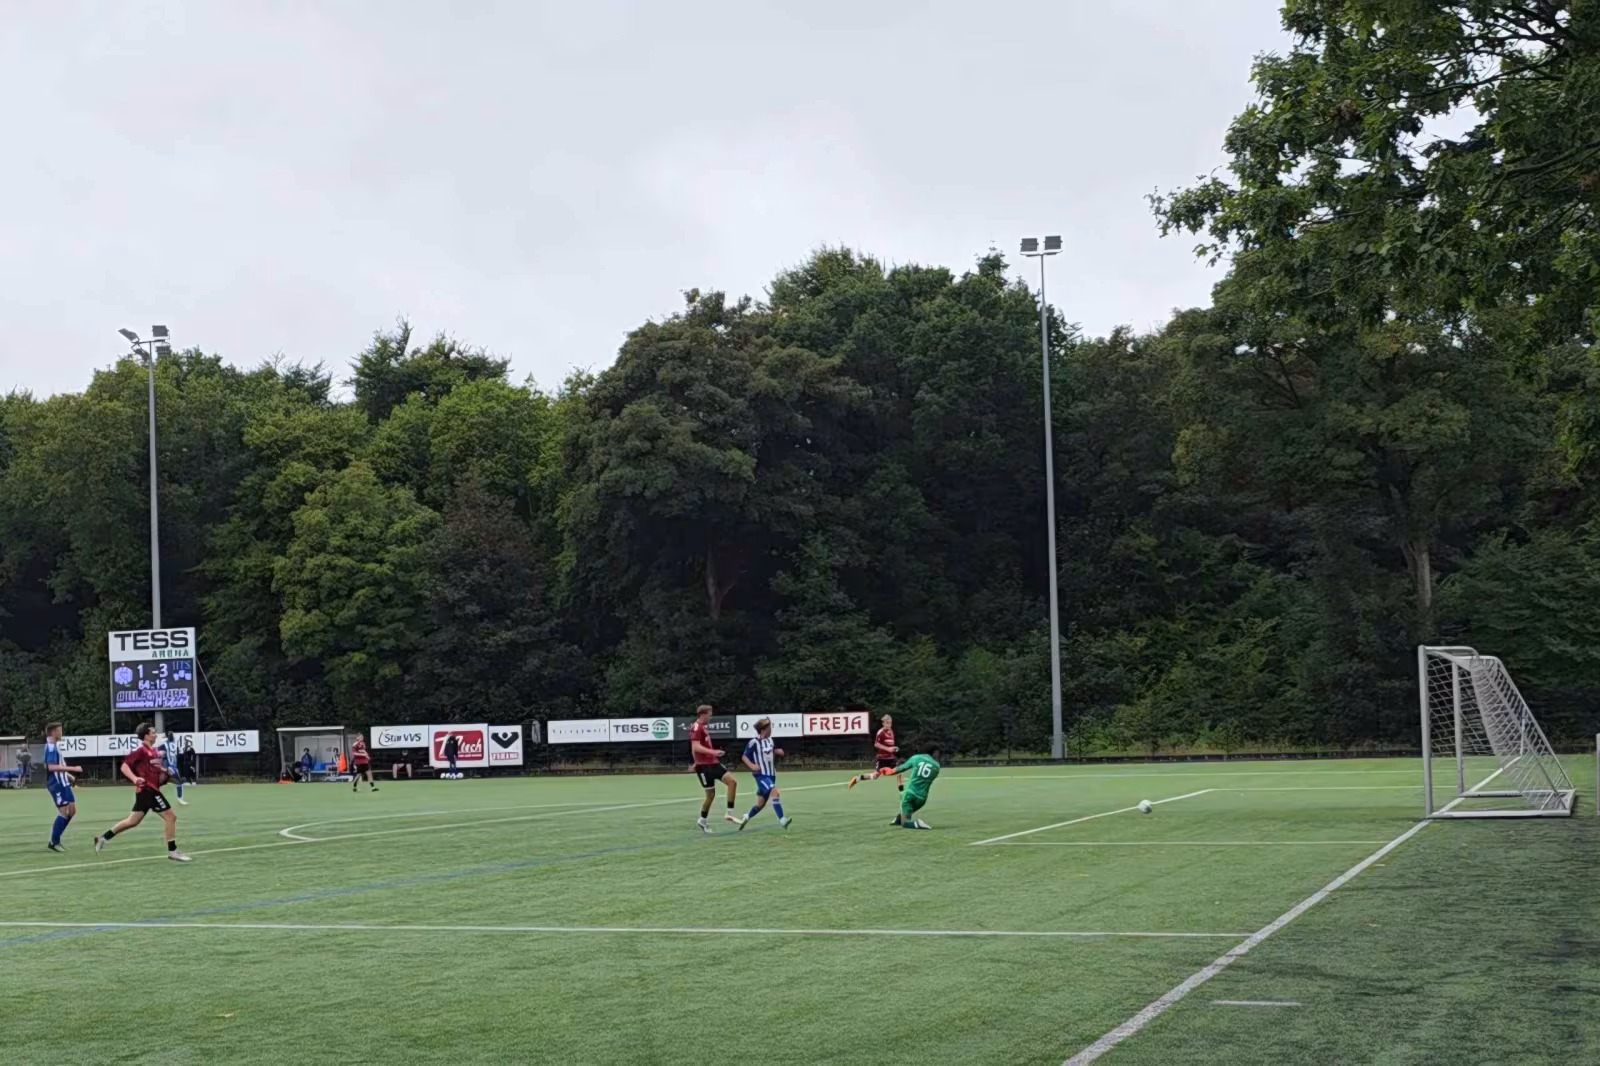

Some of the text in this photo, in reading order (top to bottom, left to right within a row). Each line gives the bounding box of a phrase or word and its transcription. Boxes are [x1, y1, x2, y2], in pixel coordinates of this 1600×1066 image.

[114, 630, 189, 651] TESS
[137, 664, 143, 678] 1
[138, 679, 167, 690] 64:16
[613, 724, 649, 734] TESS
[809, 715, 862, 733] FREJA
[59, 738, 87, 751] EMS
[108, 736, 139, 749] EMS
[216, 733, 246, 747] EMS
[917, 761, 932, 778] 16
